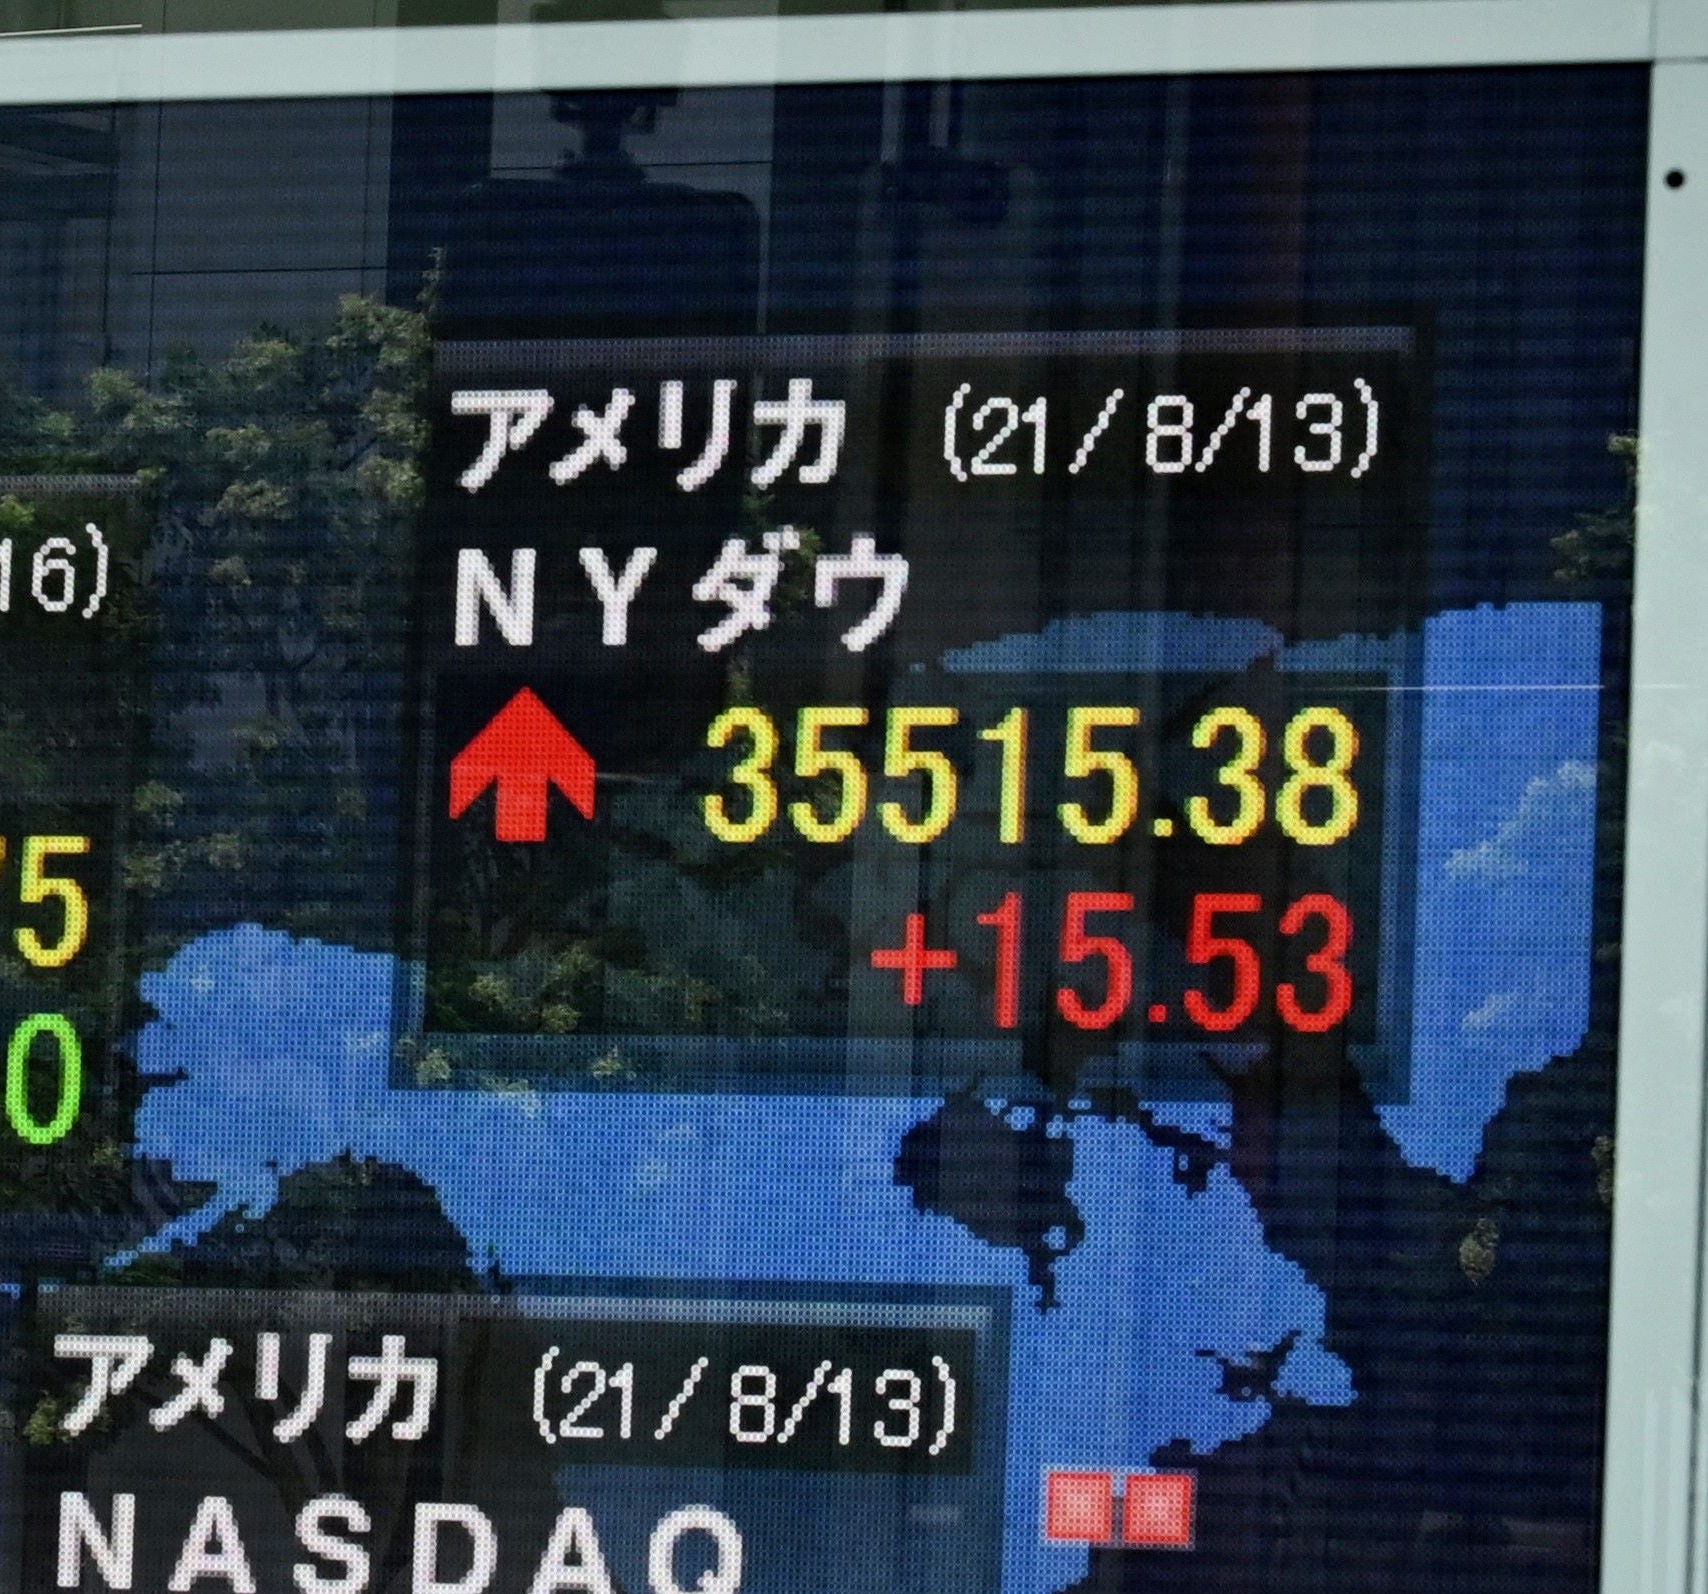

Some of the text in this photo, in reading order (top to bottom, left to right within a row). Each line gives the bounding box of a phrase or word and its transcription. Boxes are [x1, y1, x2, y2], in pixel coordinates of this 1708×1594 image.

[450, 377, 847, 493] アメリカ
[453, 523, 909, 652] NYダウ
[700, 706, 1358, 845] 35515.38
[870, 890, 1355, 1031] +15.53
[52, 1331, 439, 1443] アメリカ
